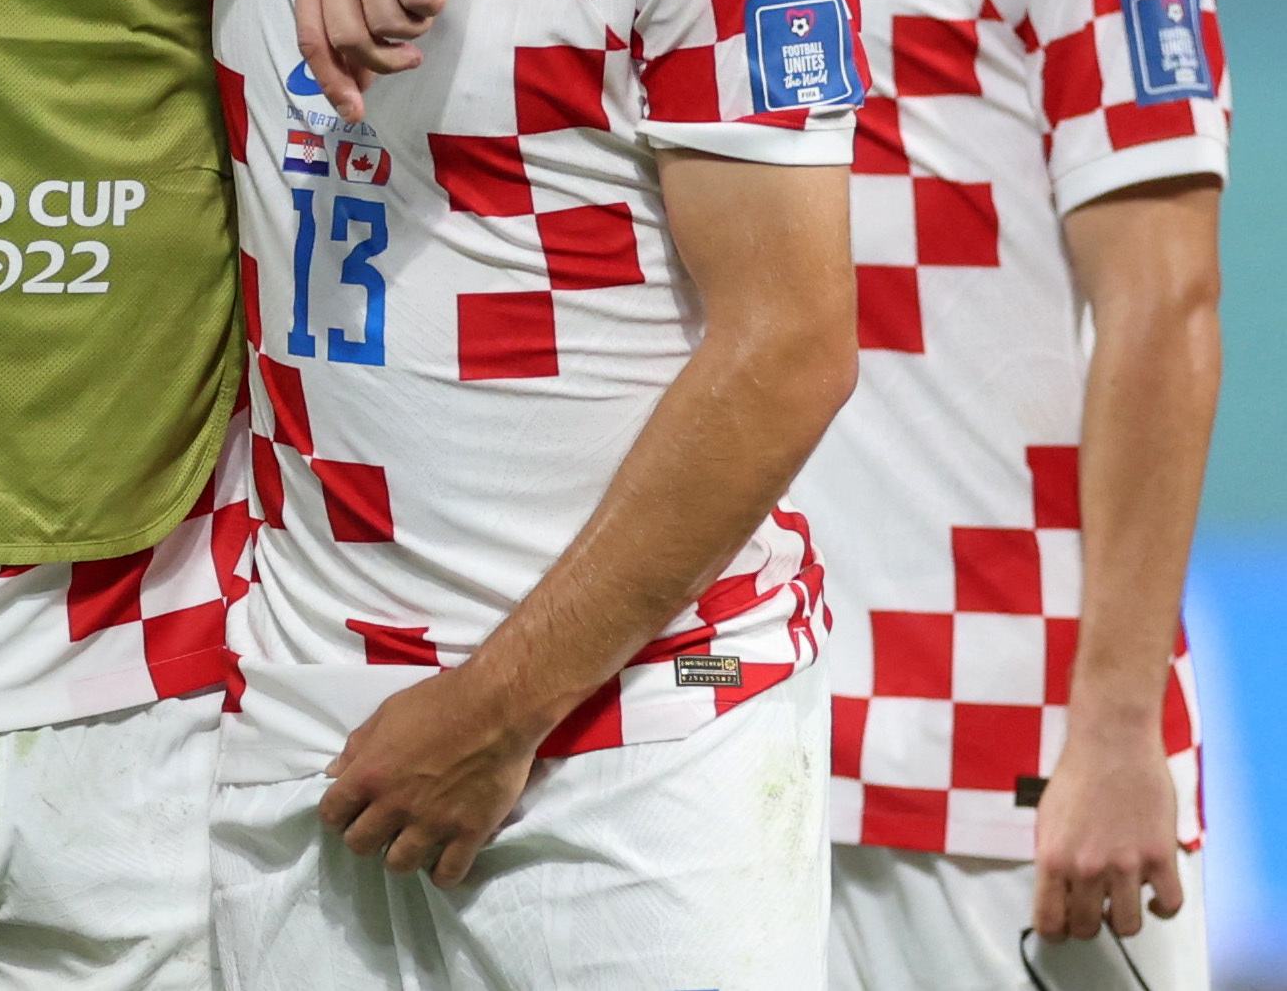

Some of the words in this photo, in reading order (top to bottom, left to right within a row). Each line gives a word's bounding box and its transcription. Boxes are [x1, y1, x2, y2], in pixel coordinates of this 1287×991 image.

[781, 41, 824, 58] FOOTBALL
[784, 54, 825, 74] UNITES
[783, 73, 802, 89] the
[801, 69, 828, 87] World
[28, 179, 147, 227] CUP
[287, 188, 389, 367] 13
